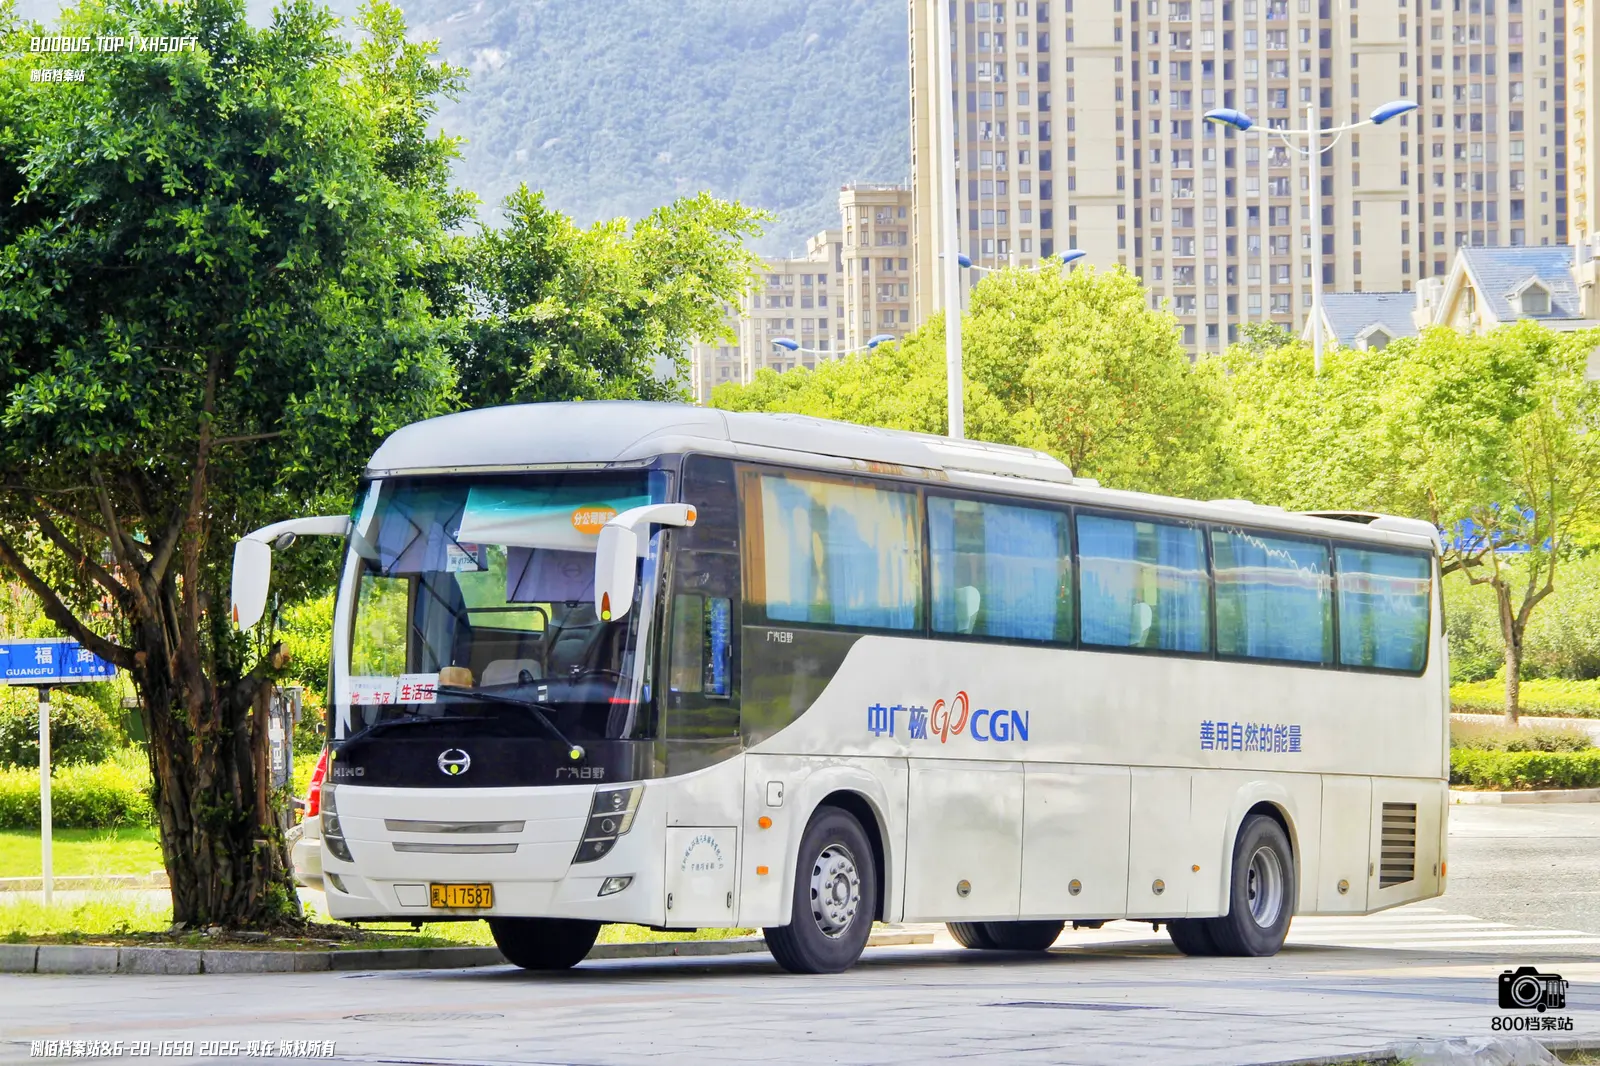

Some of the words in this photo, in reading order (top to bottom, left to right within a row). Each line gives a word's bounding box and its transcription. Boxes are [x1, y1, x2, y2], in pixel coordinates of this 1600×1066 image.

[766, 630, 793, 643] 广汽日野
[6, 667, 54, 676] GUANGFU
[400, 684, 435, 700] 生活区
[867, 703, 929, 740] 中广核
[969, 708, 1030, 742] CGN
[1200, 720, 1302, 753] 善用自然的能量
[333, 767, 365, 777] HINO
[555, 766, 605, 779] 广汽日野
